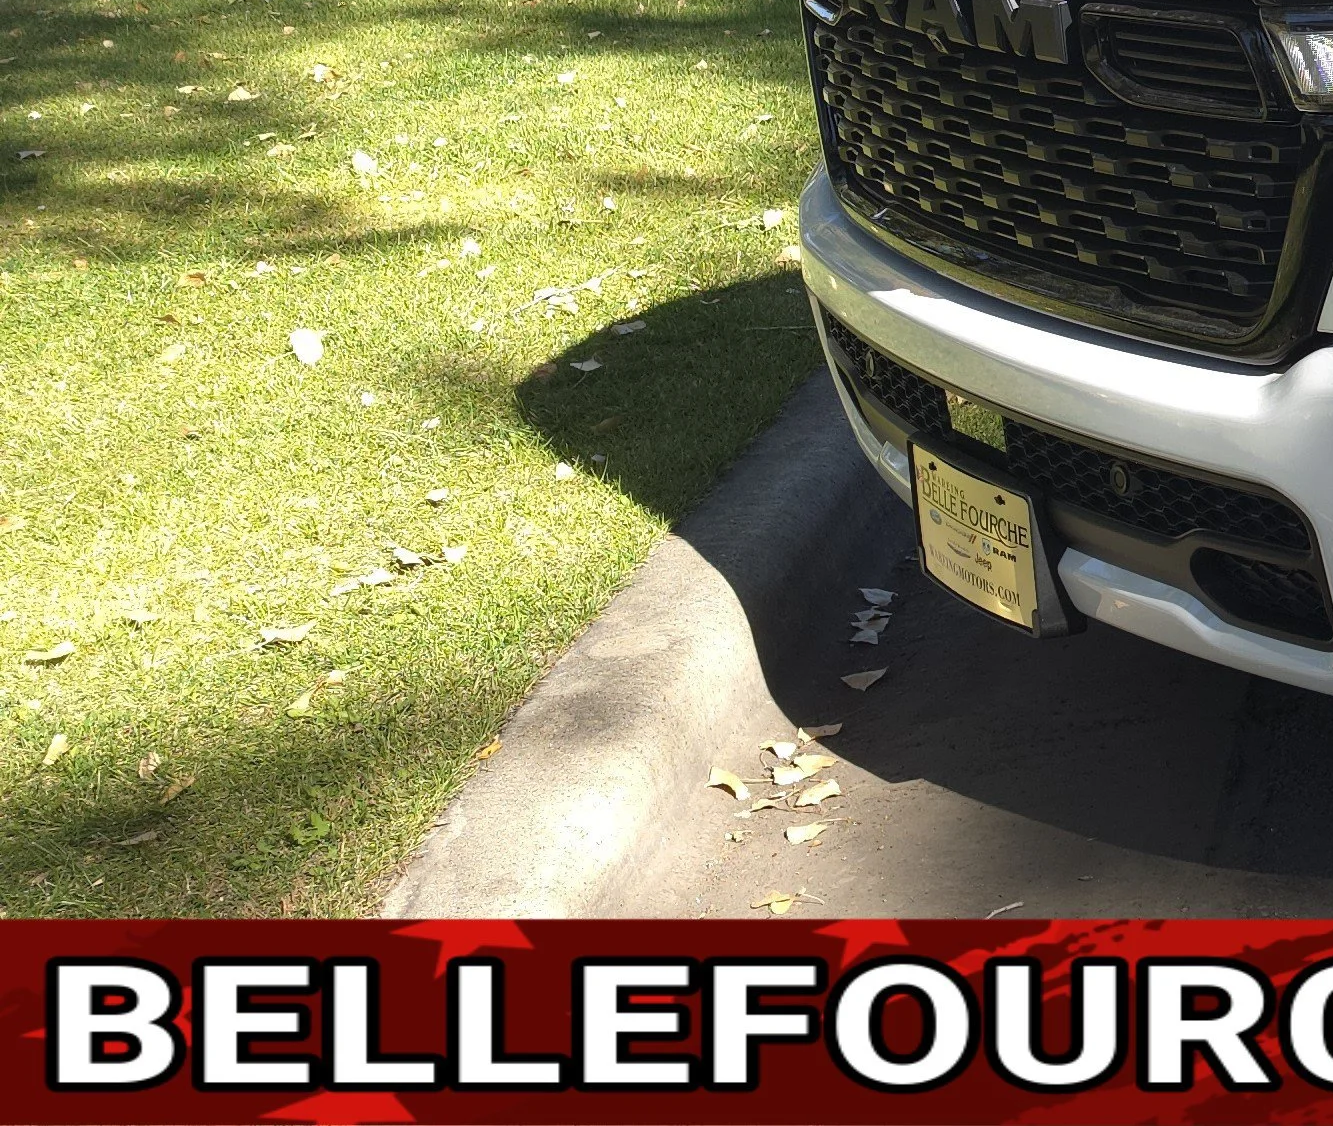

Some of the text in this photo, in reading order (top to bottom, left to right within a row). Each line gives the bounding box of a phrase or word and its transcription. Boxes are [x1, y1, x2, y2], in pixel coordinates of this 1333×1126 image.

[921, 465, 1029, 549] BELLE FOURCHE
[974, 552, 993, 572] Jeep
[992, 546, 1017, 563] RAM
